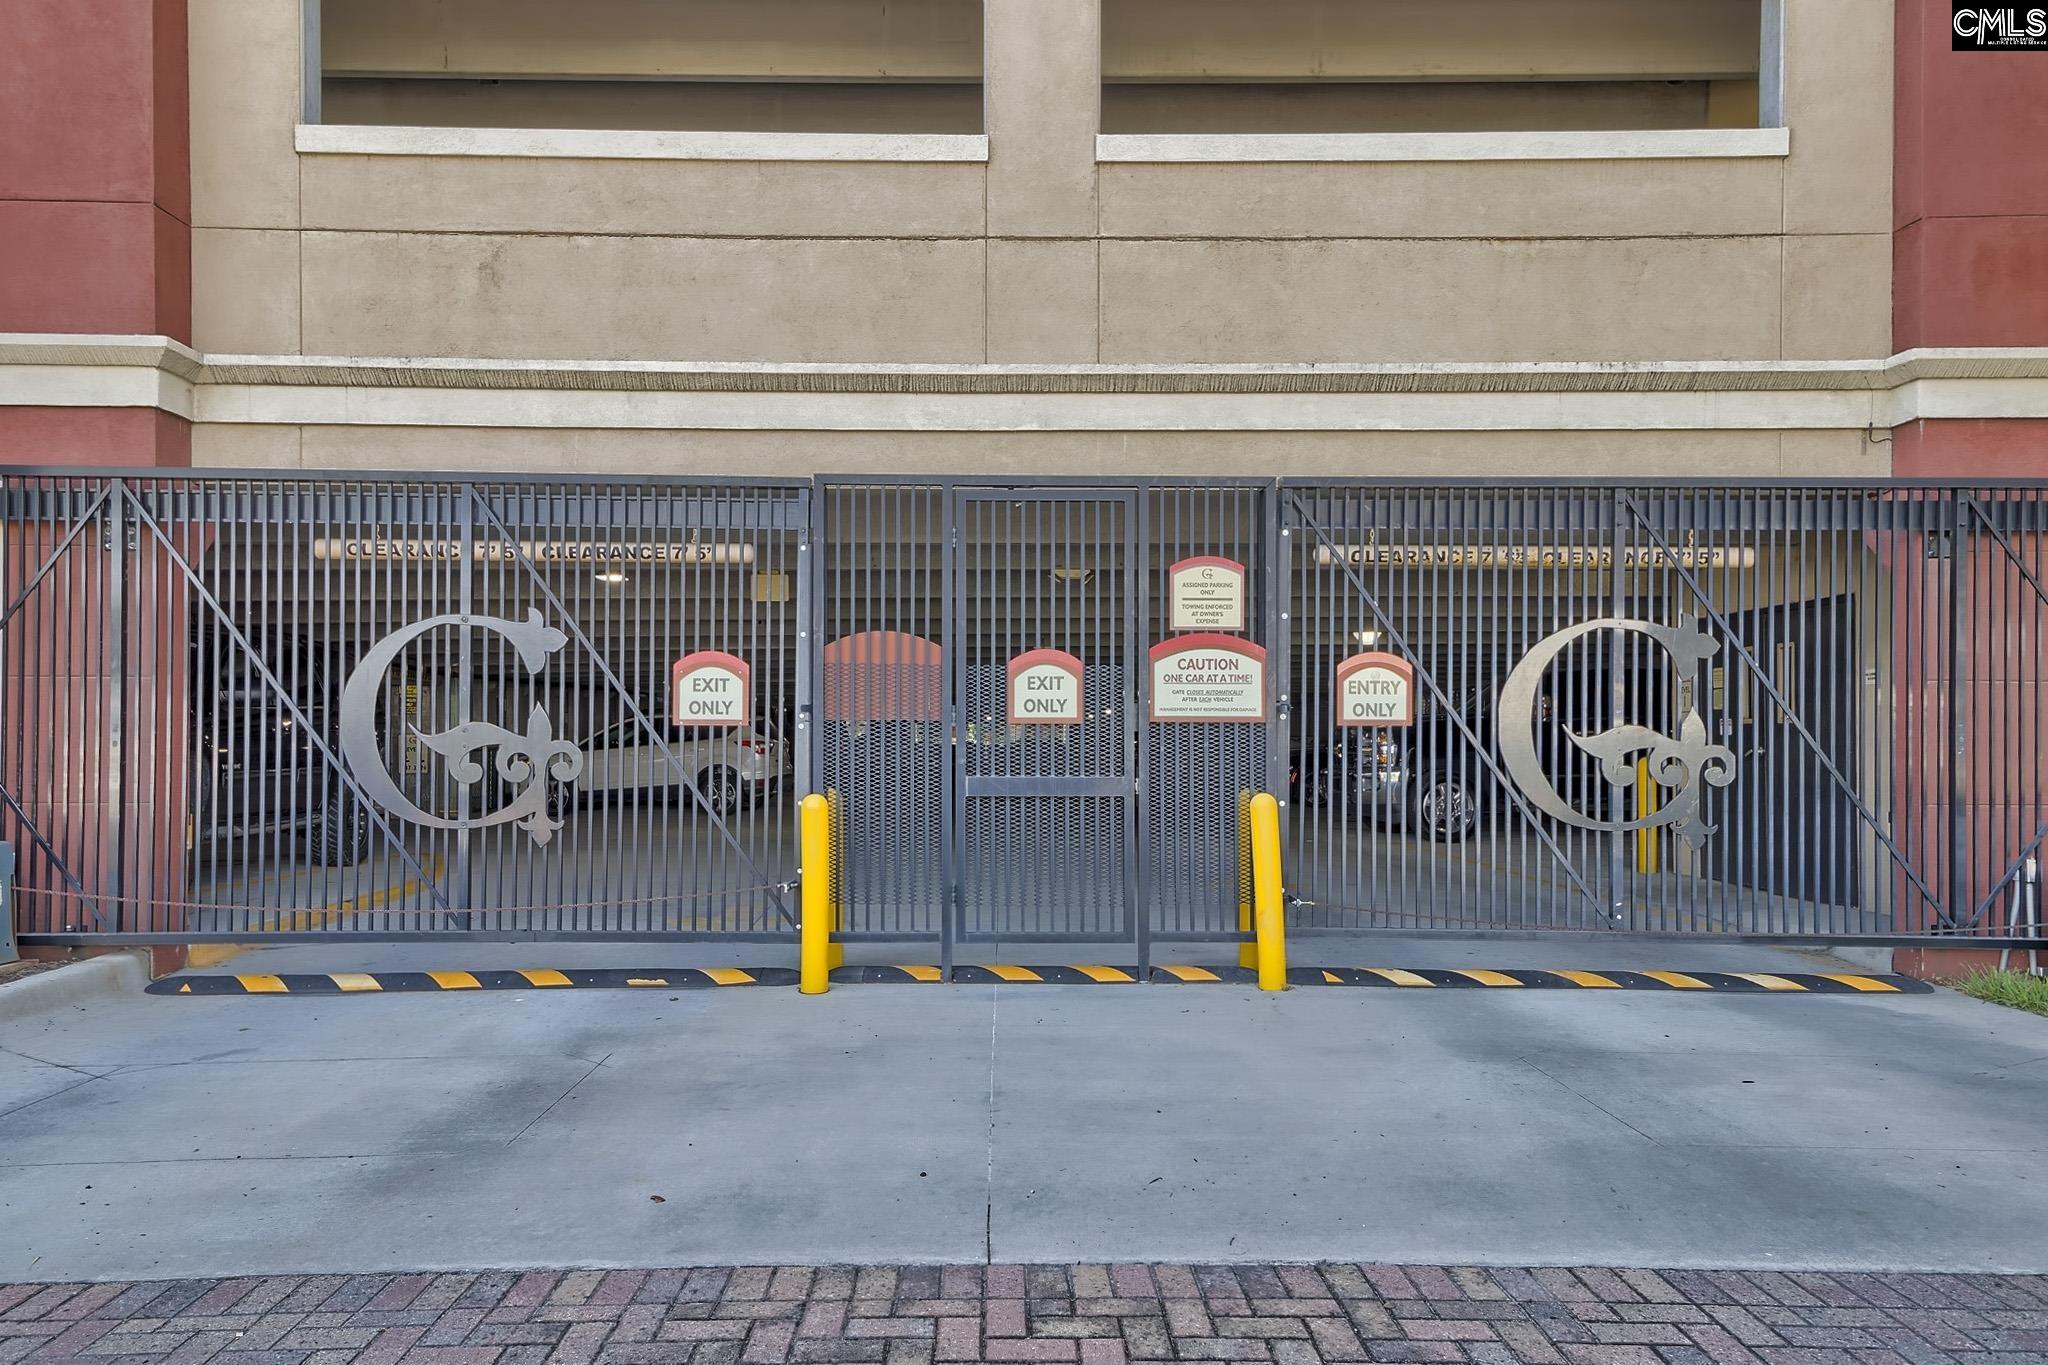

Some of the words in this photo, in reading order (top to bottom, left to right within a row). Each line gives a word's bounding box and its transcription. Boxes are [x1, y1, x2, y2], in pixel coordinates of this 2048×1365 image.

[346, 543, 472, 557] CLEARANC
[542, 546, 666, 559] CLEARANCE
[1350, 550, 1475, 563] CLEARANCE
[1543, 552, 1667, 565] CLEARNCE
[1177, 658, 1239, 670] CAUTION
[692, 678, 730, 692] EXIT
[1027, 676, 1065, 690] EXIT
[1163, 674, 1183, 682] ONE
[1185, 674, 1204, 682] CAR
[1206, 674, 1218, 682] AT
[1219, 674, 1227, 682] A
[1228, 674, 1253, 682] TIME!
[1348, 680, 1401, 695] ENTRY
[688, 701, 733, 715] ONLY
[1023, 699, 1067, 713] ONLY
[1352, 703, 1396, 717] ONLY
